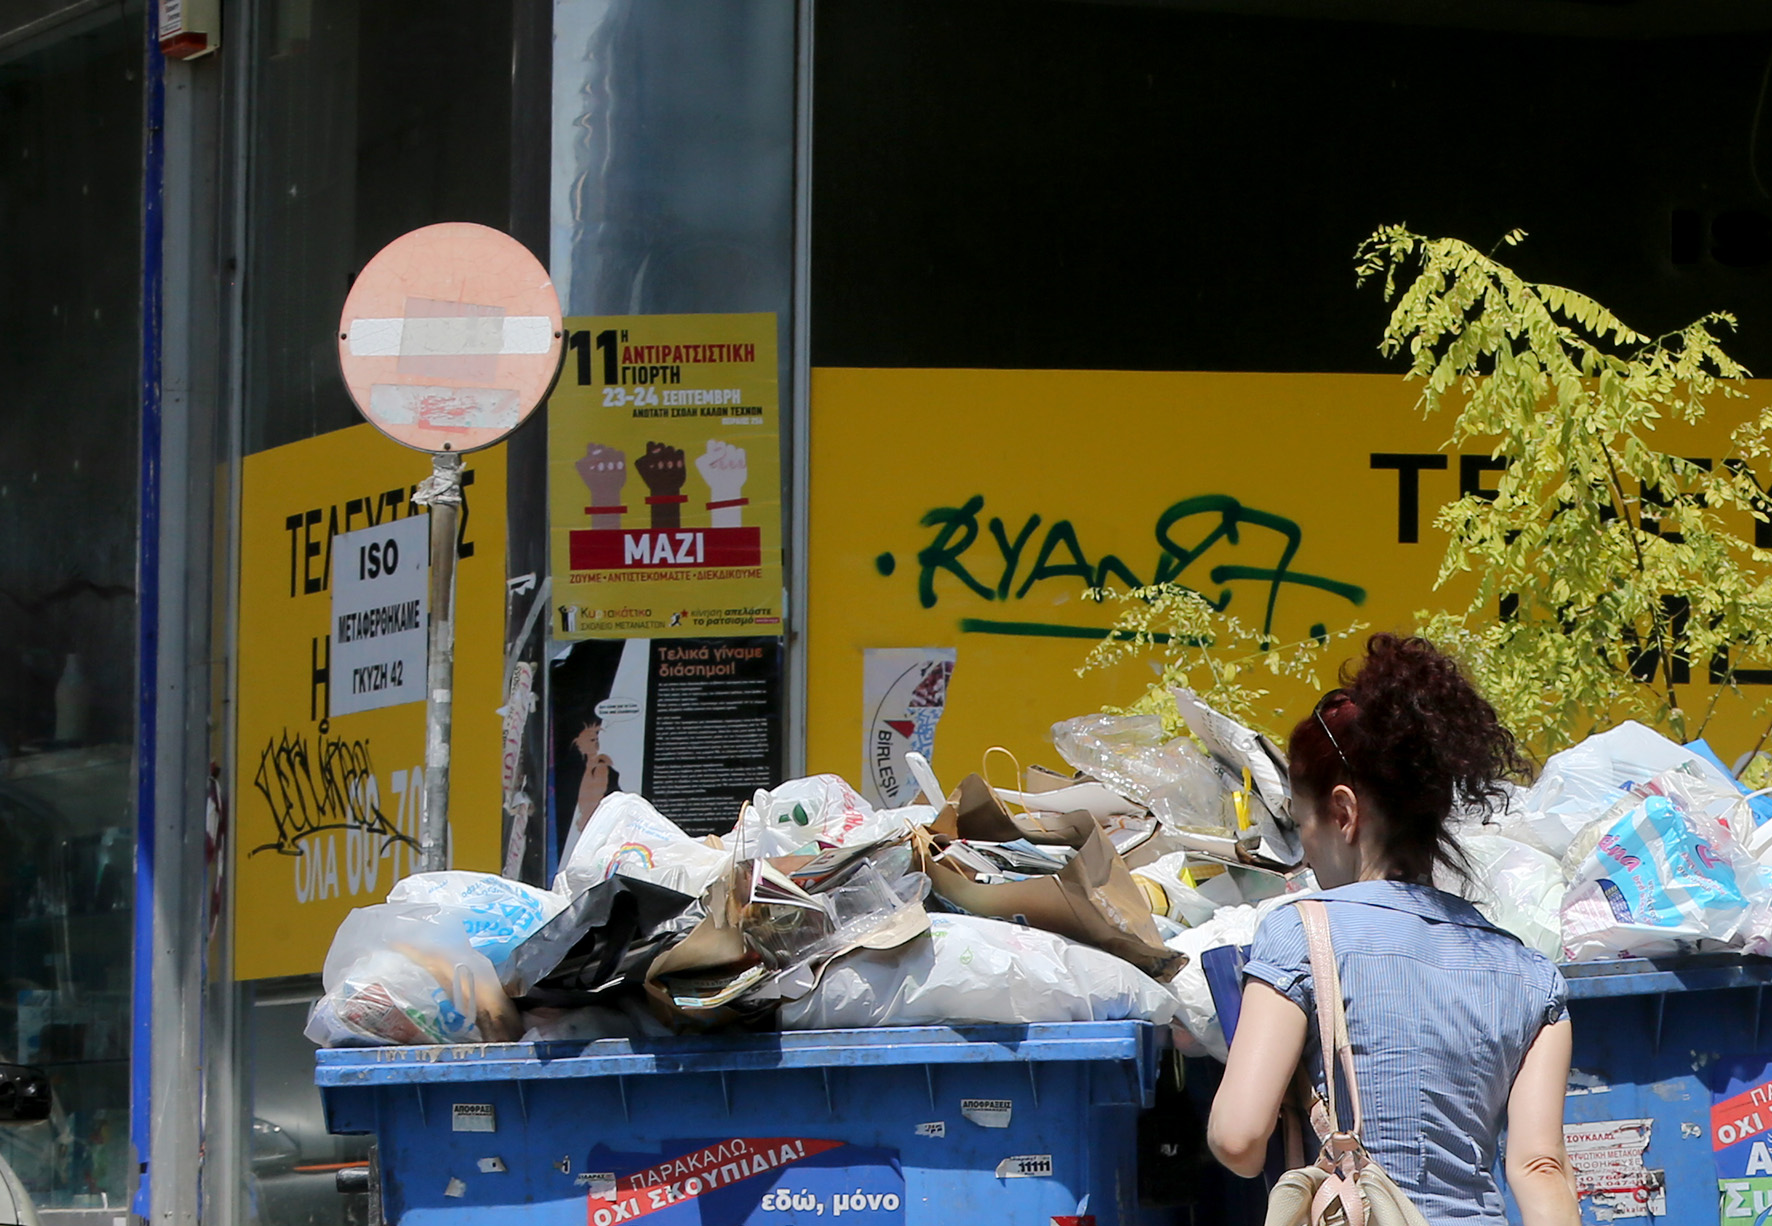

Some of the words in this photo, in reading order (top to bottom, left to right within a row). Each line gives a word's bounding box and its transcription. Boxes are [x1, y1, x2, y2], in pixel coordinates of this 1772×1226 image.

[570, 330, 618, 385] 11
[622, 344, 755, 364] ΑΝΤΙΡΑΤΣΙΣΤΙΚΗ
[621, 366, 681, 385] ΓΙΟΡΤΗ
[602, 387, 659, 407] 23-24
[662, 389, 741, 406] ΣΕΠΤΕΜΒΡΗ
[359, 538, 399, 580] ISO
[624, 532, 704, 565] ΜΑΖΙ
[570, 573, 602, 584] ΖΟΥΜΕ
[607, 572, 691, 583] ΑΝΤΙΣΤΕΚΟΜΑΣΤΕ
[697, 569, 762, 580] ΔΙΕΚΔΙΚΟΥΜΕ
[338, 600, 420, 643] ΜΕΤΑΦΕΡΘΗΚΑΜΕ
[658, 646, 709, 661] Τελικά
[714, 645, 763, 662] γίναμε
[352, 662, 389, 694] ΓΚΥΖΗ
[390, 660, 404, 687] 42
[658, 663, 736, 678] διάσημοι!
[1718, 1113, 1764, 1144] ΟΧΙ
[630, 1138, 754, 1192] ΠΑΡΑΚΑΛΩ,
[647, 1140, 806, 1210] ΣΚΟΥΠΙΔΙΑ!
[761, 1188, 825, 1215] εδώ,
[832, 1189, 900, 1215] μόνο
